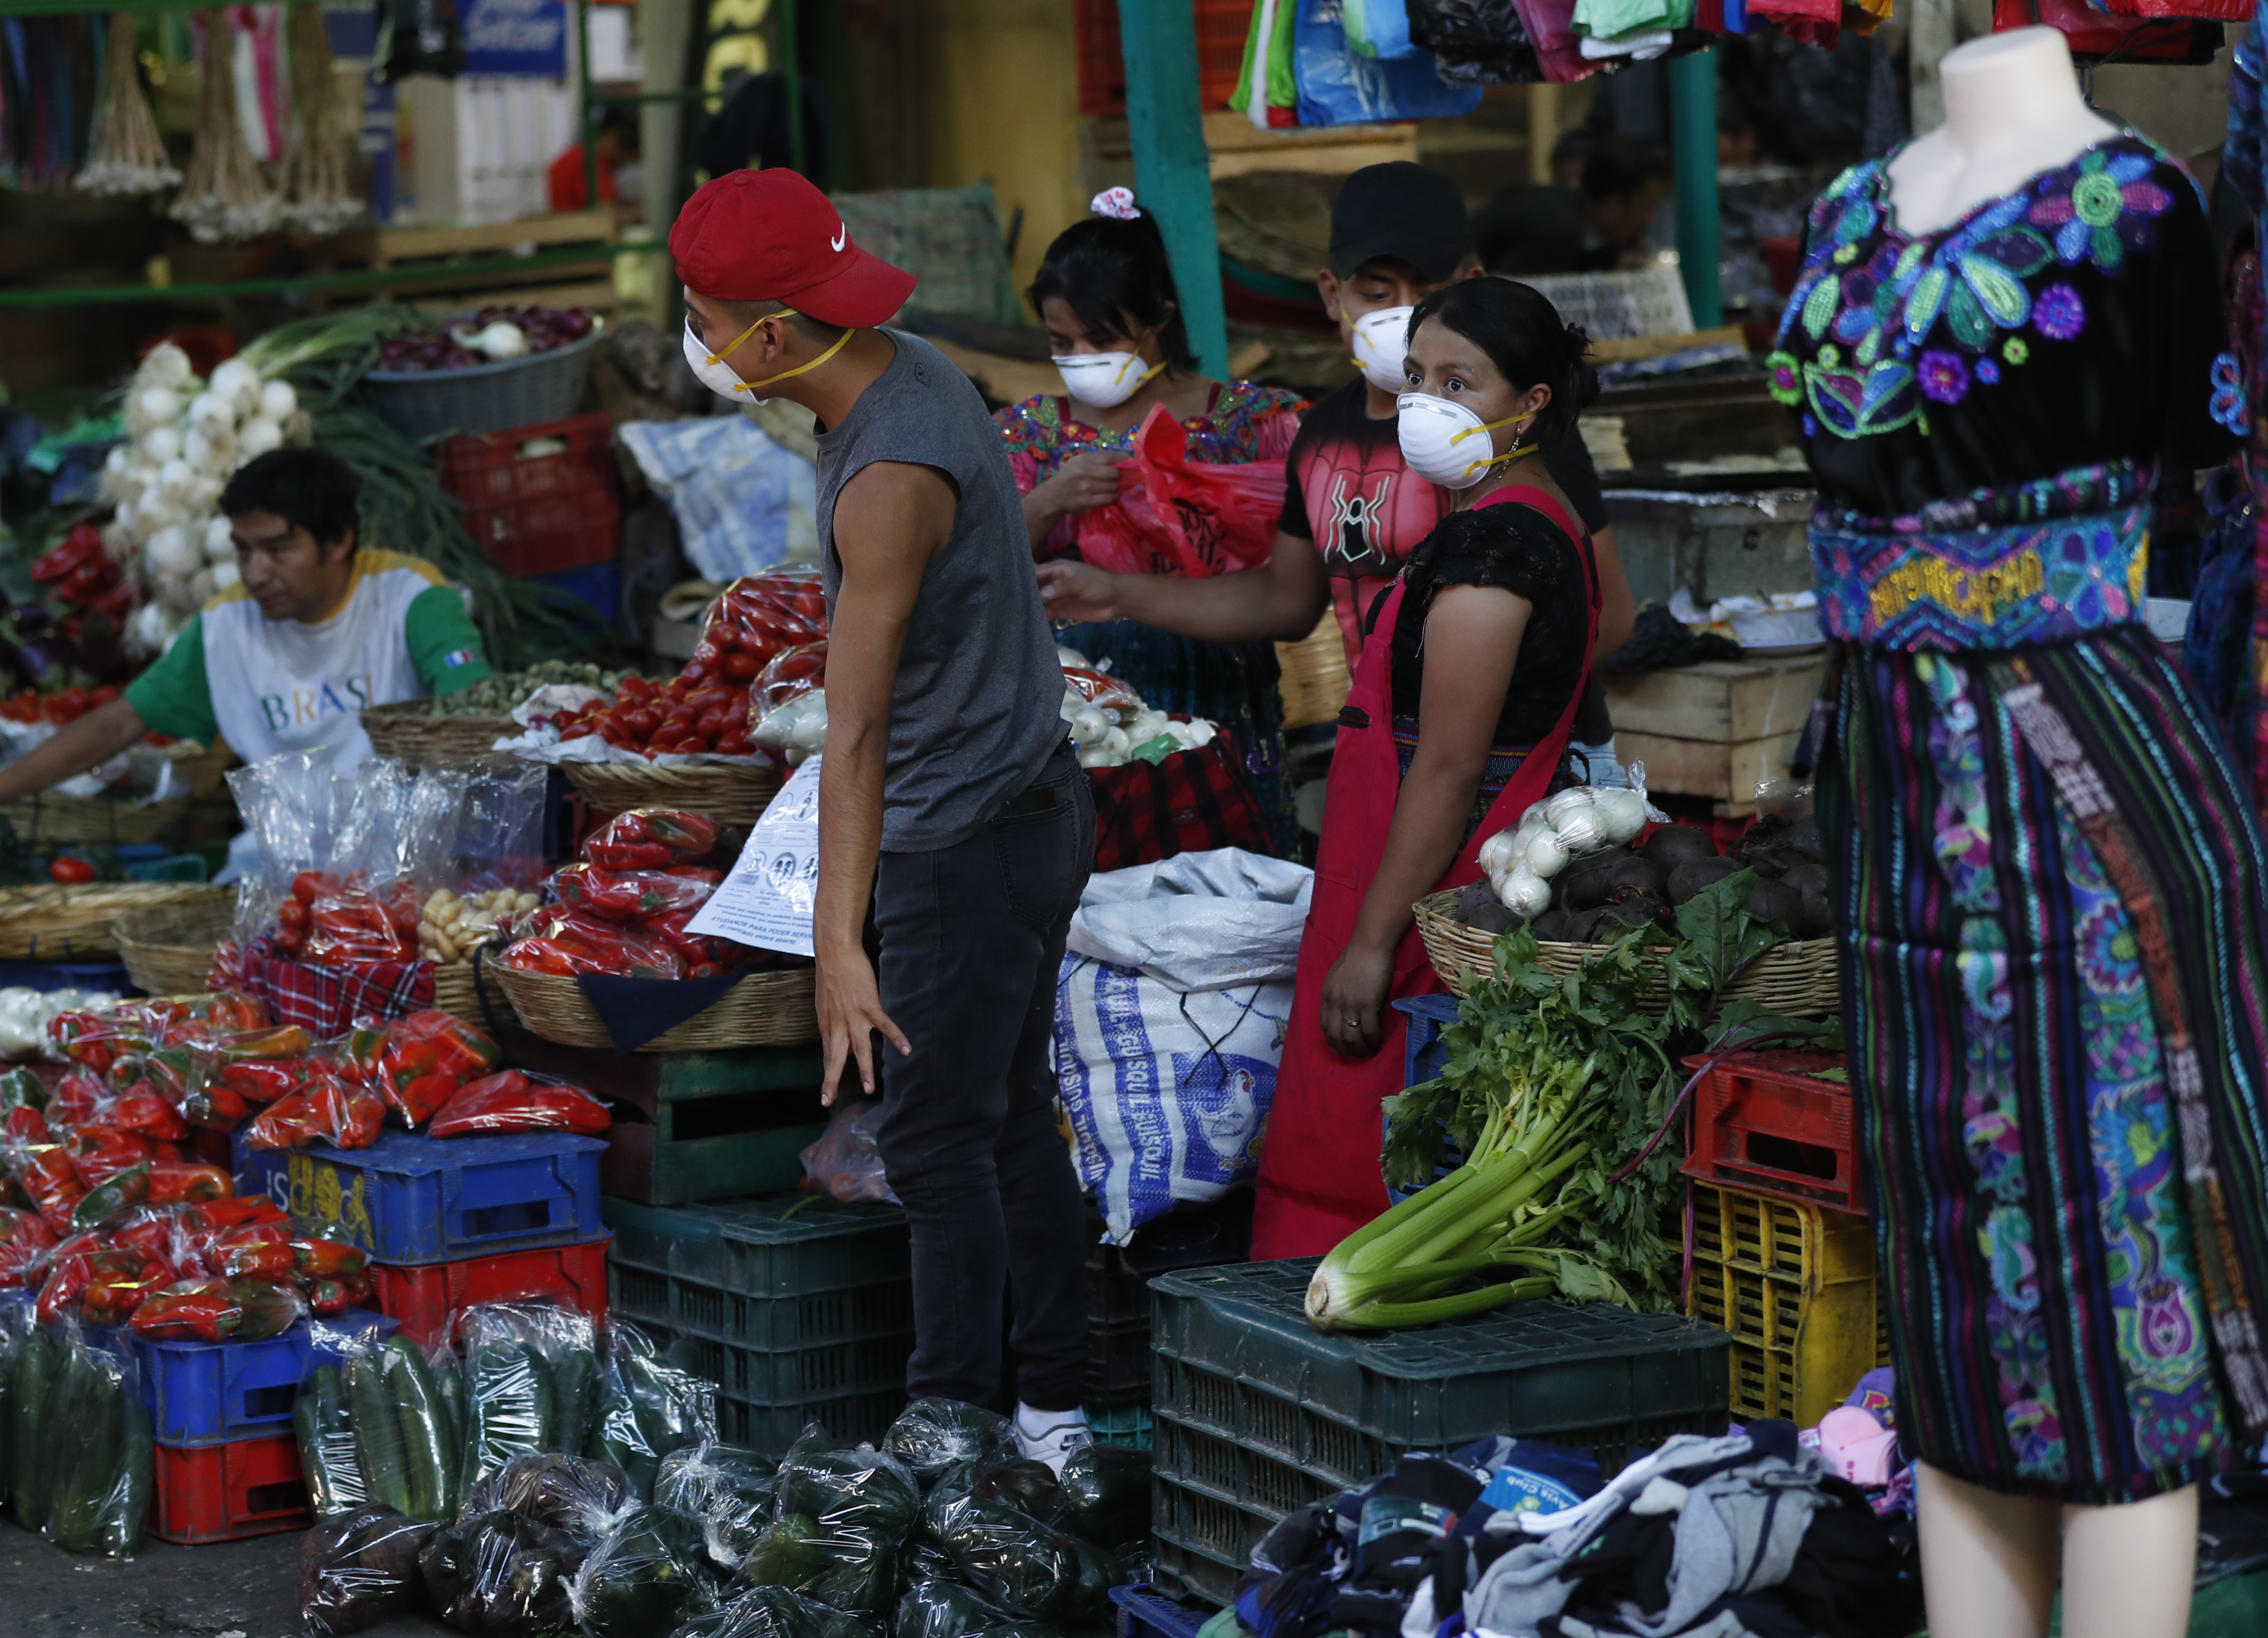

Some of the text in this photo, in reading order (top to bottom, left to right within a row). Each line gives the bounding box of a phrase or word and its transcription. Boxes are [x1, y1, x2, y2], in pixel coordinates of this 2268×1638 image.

[727, 926, 754, 937] mercado
[748, 923, 767, 933] PARA
[768, 928, 791, 936] PODER
[1506, 1475, 1539, 1494] Club
